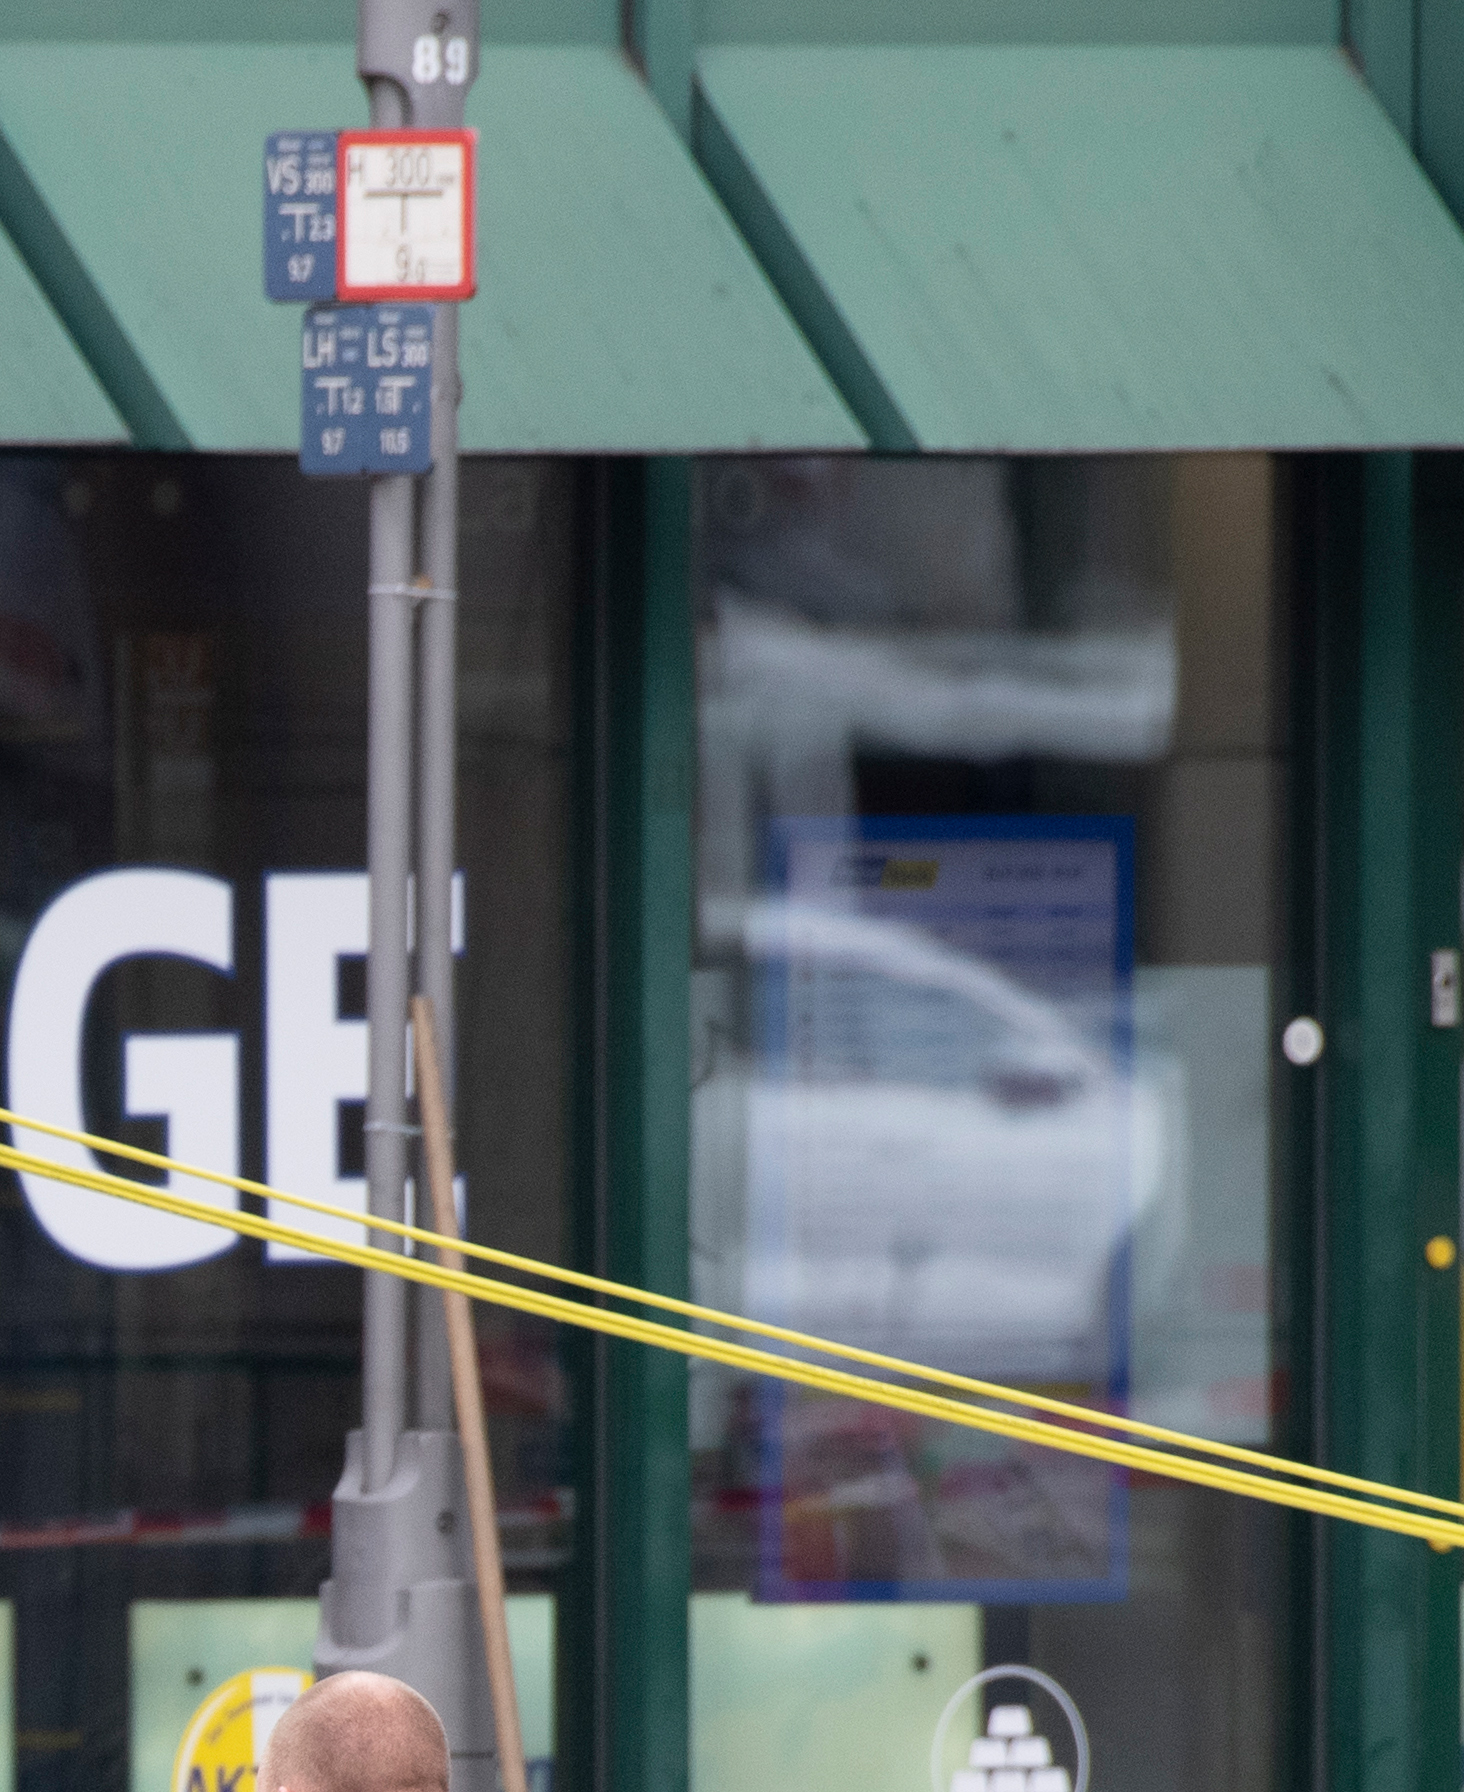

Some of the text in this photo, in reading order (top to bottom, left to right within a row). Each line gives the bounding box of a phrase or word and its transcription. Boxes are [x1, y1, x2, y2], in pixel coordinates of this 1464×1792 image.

[412, 35, 469, 85] 89
[267, 154, 302, 195] VS
[386, 148, 431, 187] 300
[303, 329, 336, 368] LH
[367, 327, 400, 367] LS
